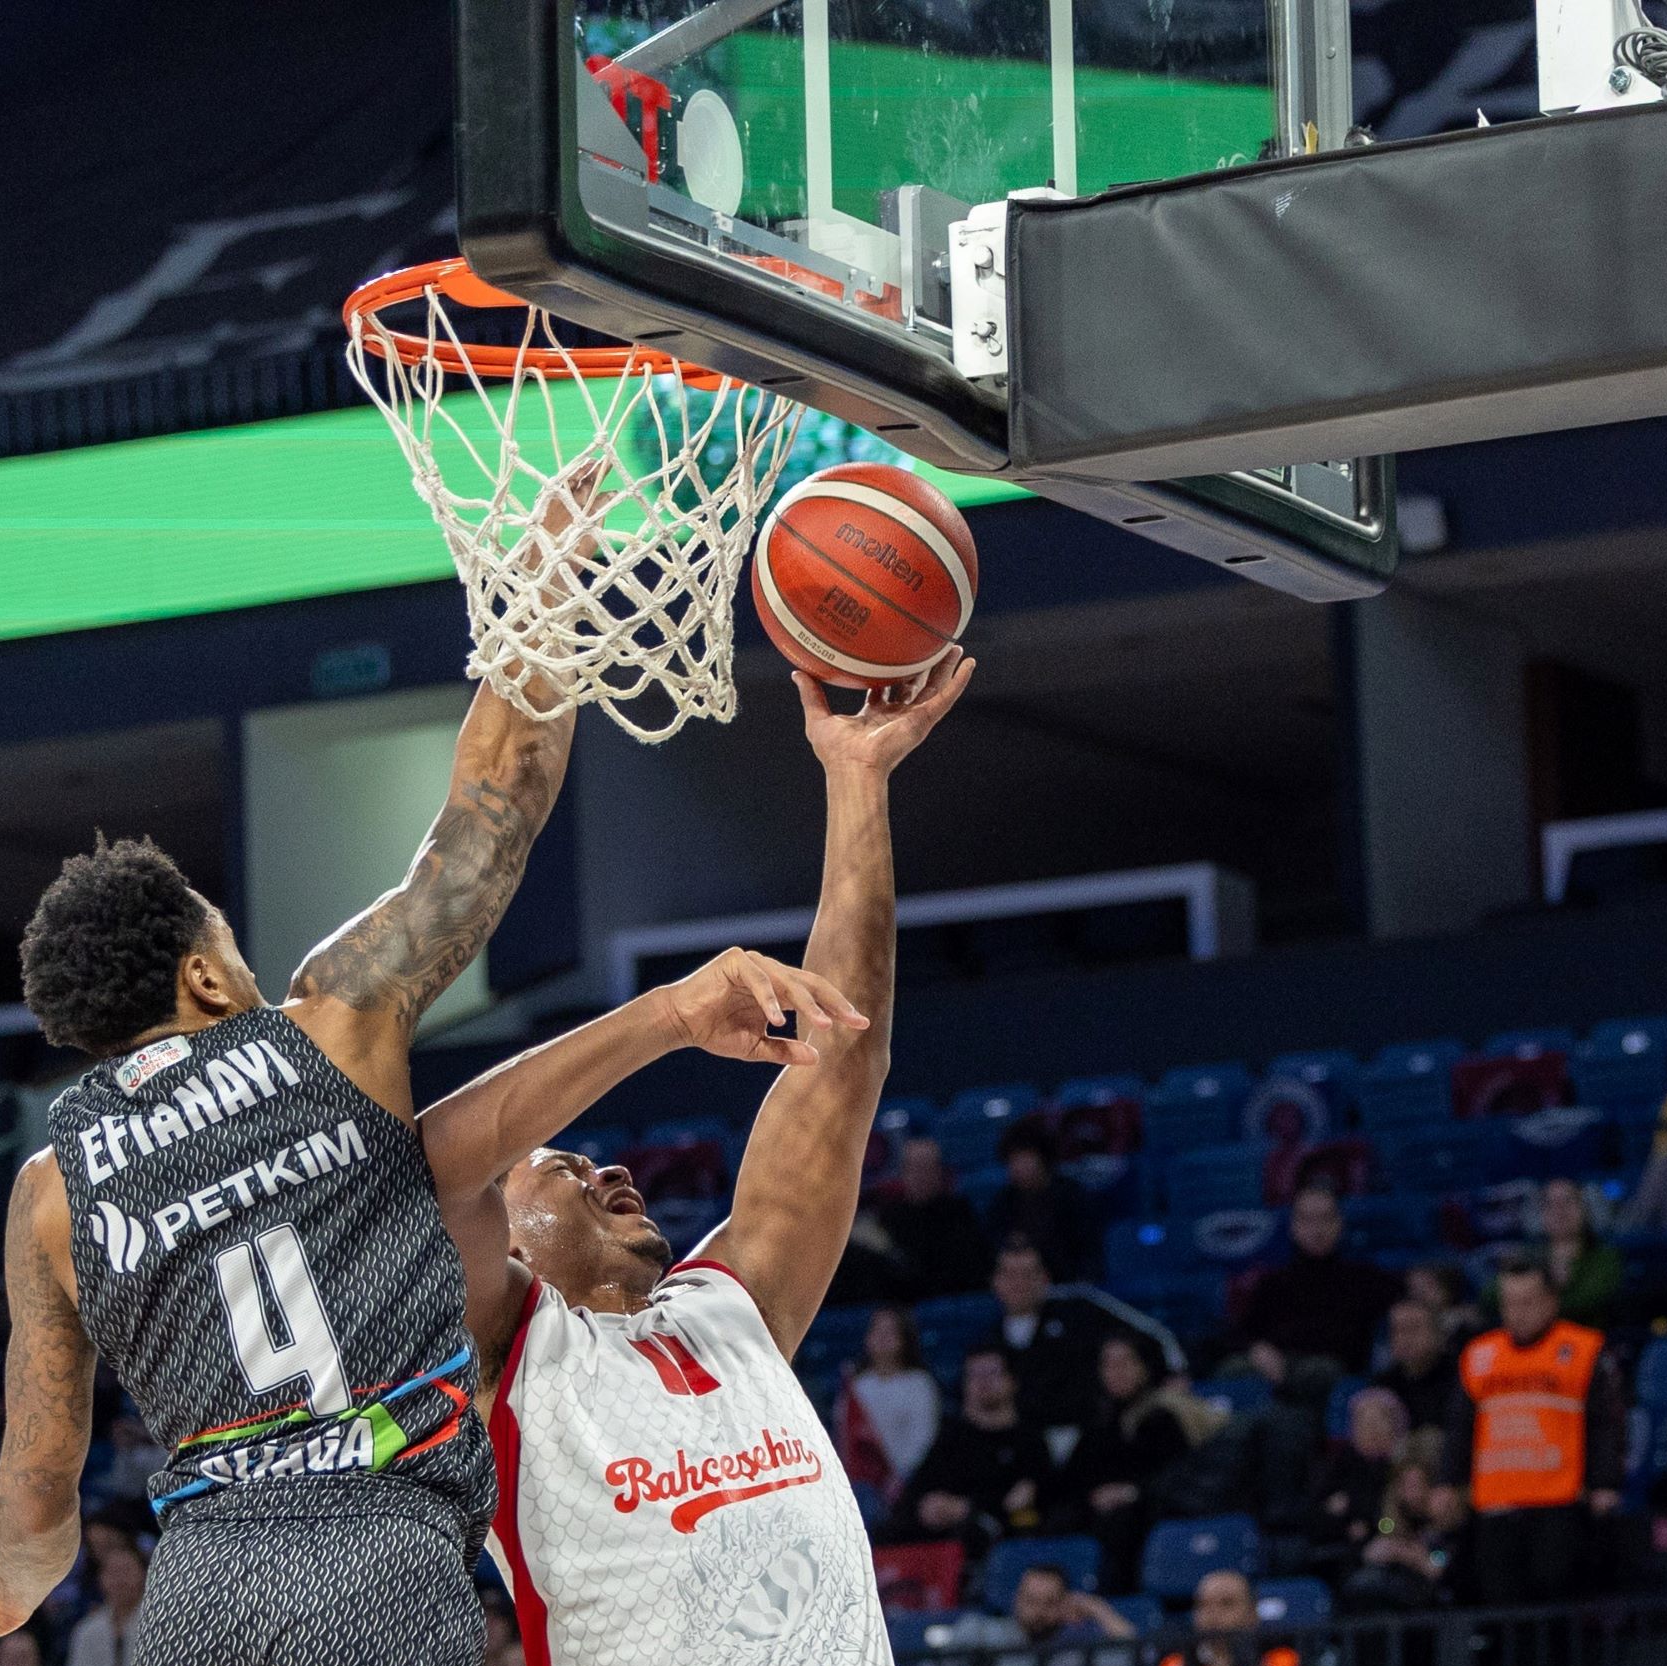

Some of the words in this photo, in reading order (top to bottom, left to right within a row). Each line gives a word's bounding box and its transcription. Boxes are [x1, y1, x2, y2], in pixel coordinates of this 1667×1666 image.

[834, 521, 925, 593] molten
[824, 586, 872, 627] FIBA
[79, 1039, 301, 1186] EFIANAYI
[213, 1222, 353, 1419] 4
[625, 1331, 722, 1397] 11
[605, 1426, 821, 1514] Bahçeşehir
